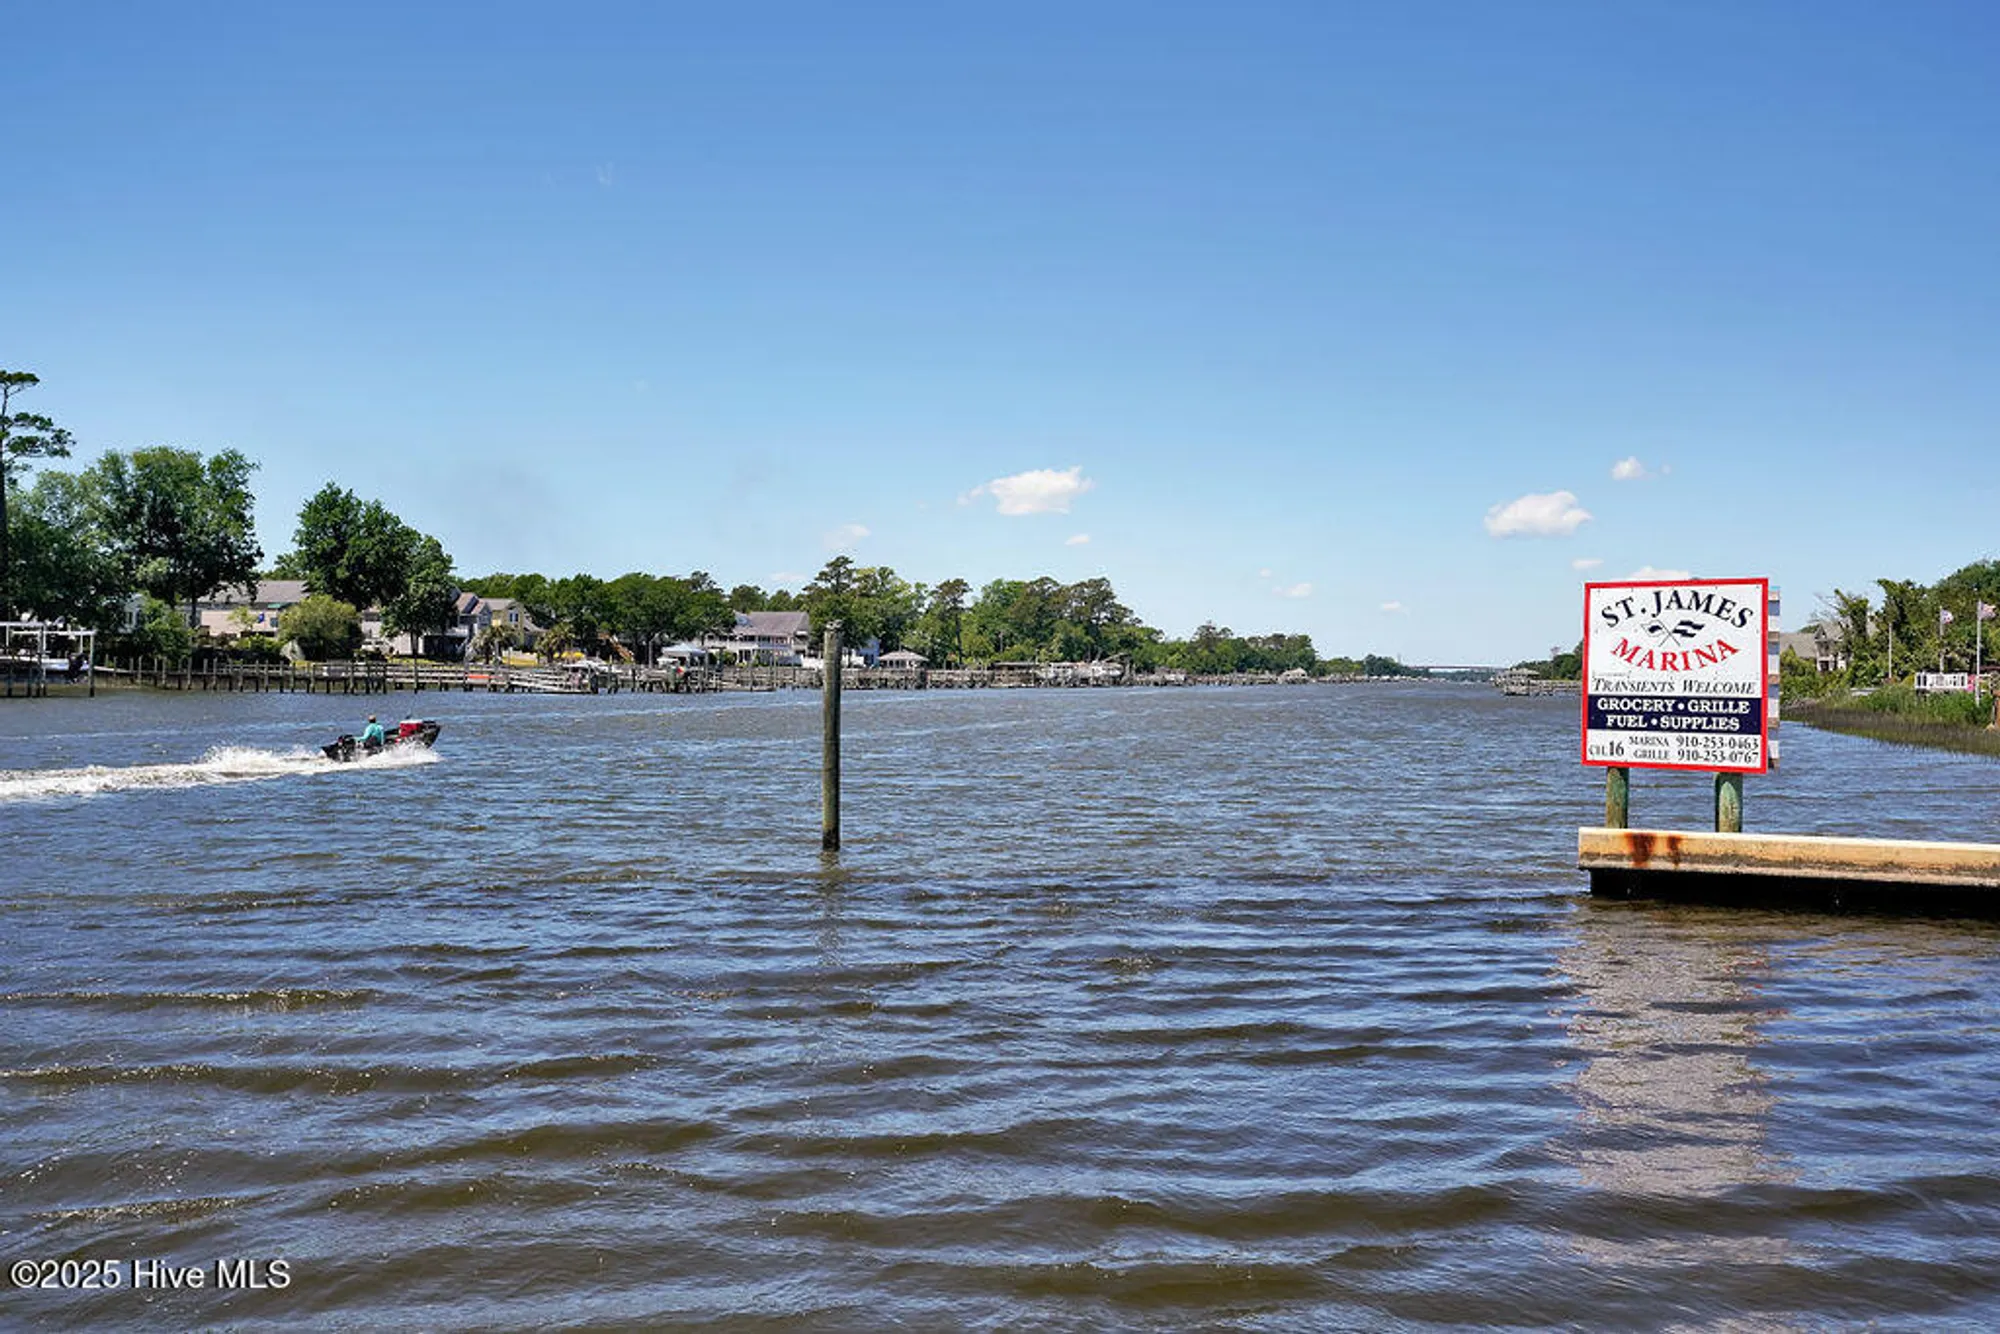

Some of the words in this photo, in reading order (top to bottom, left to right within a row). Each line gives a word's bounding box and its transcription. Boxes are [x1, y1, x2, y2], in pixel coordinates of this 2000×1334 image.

[1601, 597, 1647, 628] ST.
[1651, 590, 1753, 628] JAMES
[1611, 637, 1740, 671] MARINA
[1593, 678, 1675, 692] TRANSIENTS
[1682, 679, 1756, 694] WELCOME
[1597, 698, 1675, 711] GROCERY
[1687, 700, 1750, 713] GRILLE
[1606, 715, 1648, 728] FUEL
[1660, 717, 1740, 731] SUPPLIES
[1629, 736, 1669, 747] MARINA
